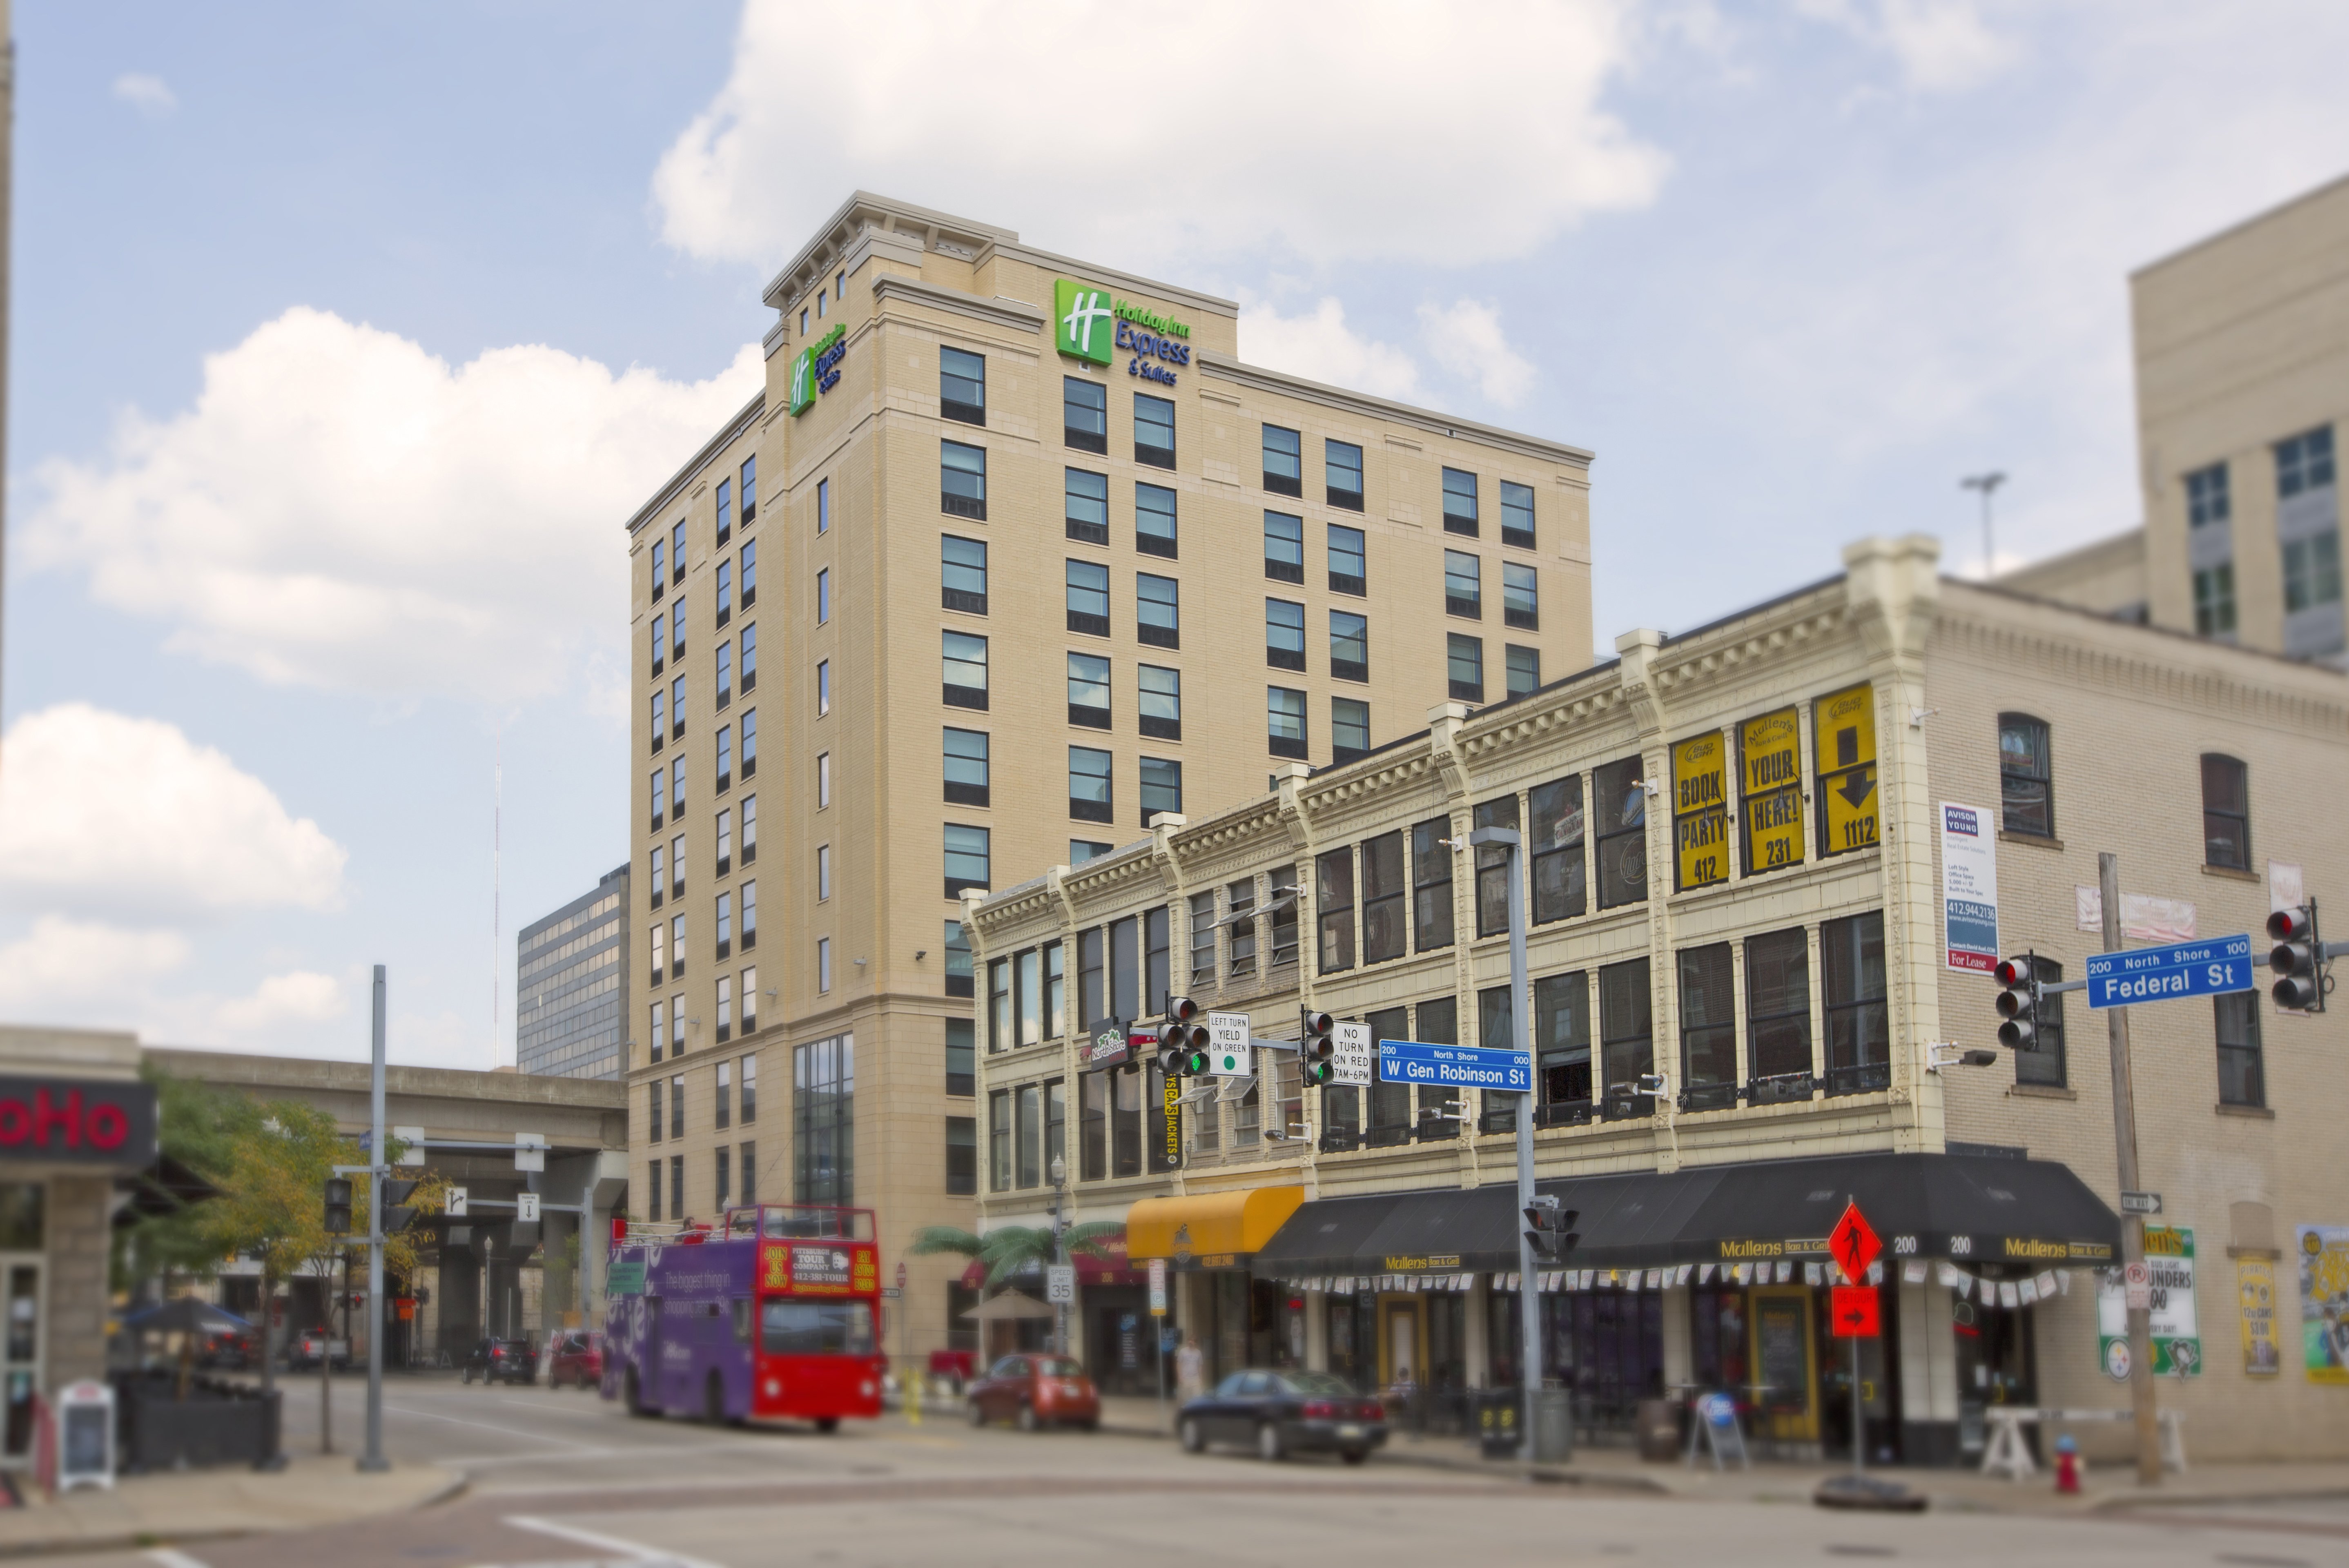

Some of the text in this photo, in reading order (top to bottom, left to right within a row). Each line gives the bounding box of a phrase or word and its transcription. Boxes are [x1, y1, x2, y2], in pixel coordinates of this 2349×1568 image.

[1114, 299, 1190, 339] Holiday Inn
[1116, 321, 1190, 365] Express
[814, 340, 847, 380] Express
[1129, 358, 1177, 386] & Suites
[1838, 697, 1861, 708] BUD
[1834, 702, 1863, 717] LIGHT
[1748, 718, 1794, 745] Mullen's
[1772, 732, 1787, 742] Grill
[1688, 748, 1715, 761] LIGHT
[1693, 742, 1714, 754] BUD
[1681, 749, 1793, 808] BOOK YOUR
[1681, 793, 1799, 851] PARTY HERE!
[1948, 810, 1976, 822] AVISON
[1948, 821, 1977, 833] YOUNG
[1694, 815, 1875, 883] 412 231 1112
[1948, 902, 1995, 920] 412.944.2136
[1948, 915, 1995, 927] www.avisonyoung.com
[1951, 953, 1987, 969] For Lease
[2089, 941, 2247, 975] 200 North Shore 100
[2105, 964, 2234, 1000] Federal St
[1211, 1017, 1246, 1027] LEFT TURN
[1219, 1029, 1240, 1040] YIELD
[1344, 1028, 1357, 1038] NO
[1109, 1039, 1126, 1055] Shore
[1212, 1043, 1246, 1053] ON GREEN
[1339, 1042, 1363, 1053] TURN
[1334, 1054, 1368, 1067] ON RED
[1382, 1046, 1529, 1065] 200 North Shore 000
[1334, 1068, 1368, 1080] 7AM-6PM
[1387, 1060, 1525, 1085] W Gen Robinson St
[1166, 1074, 1177, 1088] YS
[1167, 1116, 1178, 1154] JACKETS
[2124, 1198, 2148, 1207] ONE WAY
[1721, 1240, 1782, 1257] Mullens
[1785, 1243, 1801, 1251] Bar
[1803, 1242, 1810, 1250] &
[1894, 1236, 1971, 1254] 200 200
[2006, 1238, 2111, 1258] Mullens Bar & Grill
[765, 1247, 787, 1260] JOIN
[798, 1255, 825, 1263] TOUR
[857, 1251, 871, 1263] PAY
[769, 1261, 783, 1273] US
[1202, 1255, 1234, 1267] 412.697.2461
[1386, 1256, 1427, 1270] Mullens
[2165, 1261, 2179, 1270] LIGHT
[854, 1264, 874, 1276] AS YOU
[665, 1269, 730, 1293] The biggest thing in
[765, 1274, 787, 1287] NOW
[793, 1273, 848, 1282] 412-381-TOUR
[967, 1278, 976, 1287] 210
[1101, 1272, 1113, 1282] 208
[2148, 1270, 2191, 1288] UNDERS
[792, 1285, 830, 1293] Sightseeing
[854, 1279, 874, 1291] BOARD
[1052, 1284, 1070, 1298] 35
[1838, 1293, 1872, 1303] DETOUR
[664, 1296, 693, 1319] shopping
[2257, 1307, 2273, 1319] CANS
[1709, 1408, 1734, 1416] LIGHT
